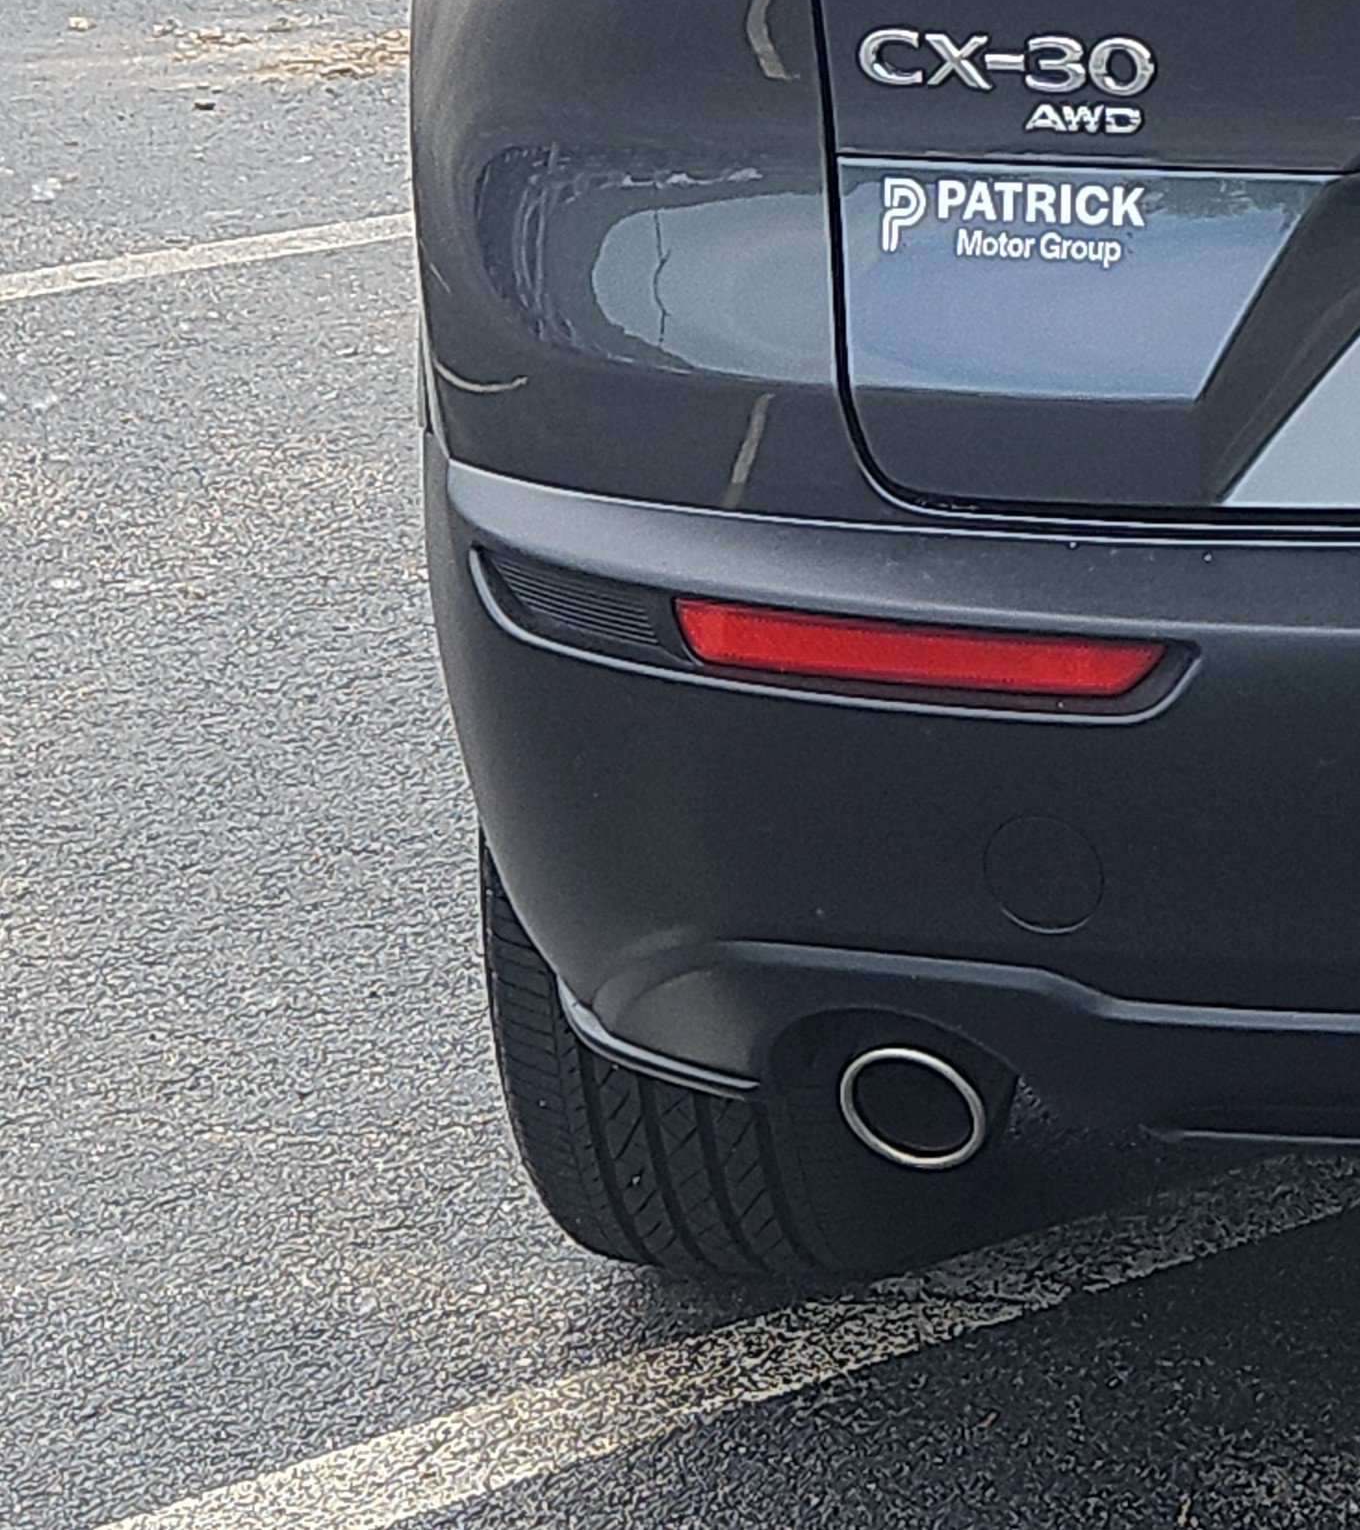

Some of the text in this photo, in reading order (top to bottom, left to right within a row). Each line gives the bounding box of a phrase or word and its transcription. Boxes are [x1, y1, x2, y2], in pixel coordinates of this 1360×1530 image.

[858, 28, 1155, 96] CX-30
[1024, 103, 1142, 134] AWD
[937, 179, 1145, 227] PATRICK
[956, 228, 1122, 268] Motor Group
